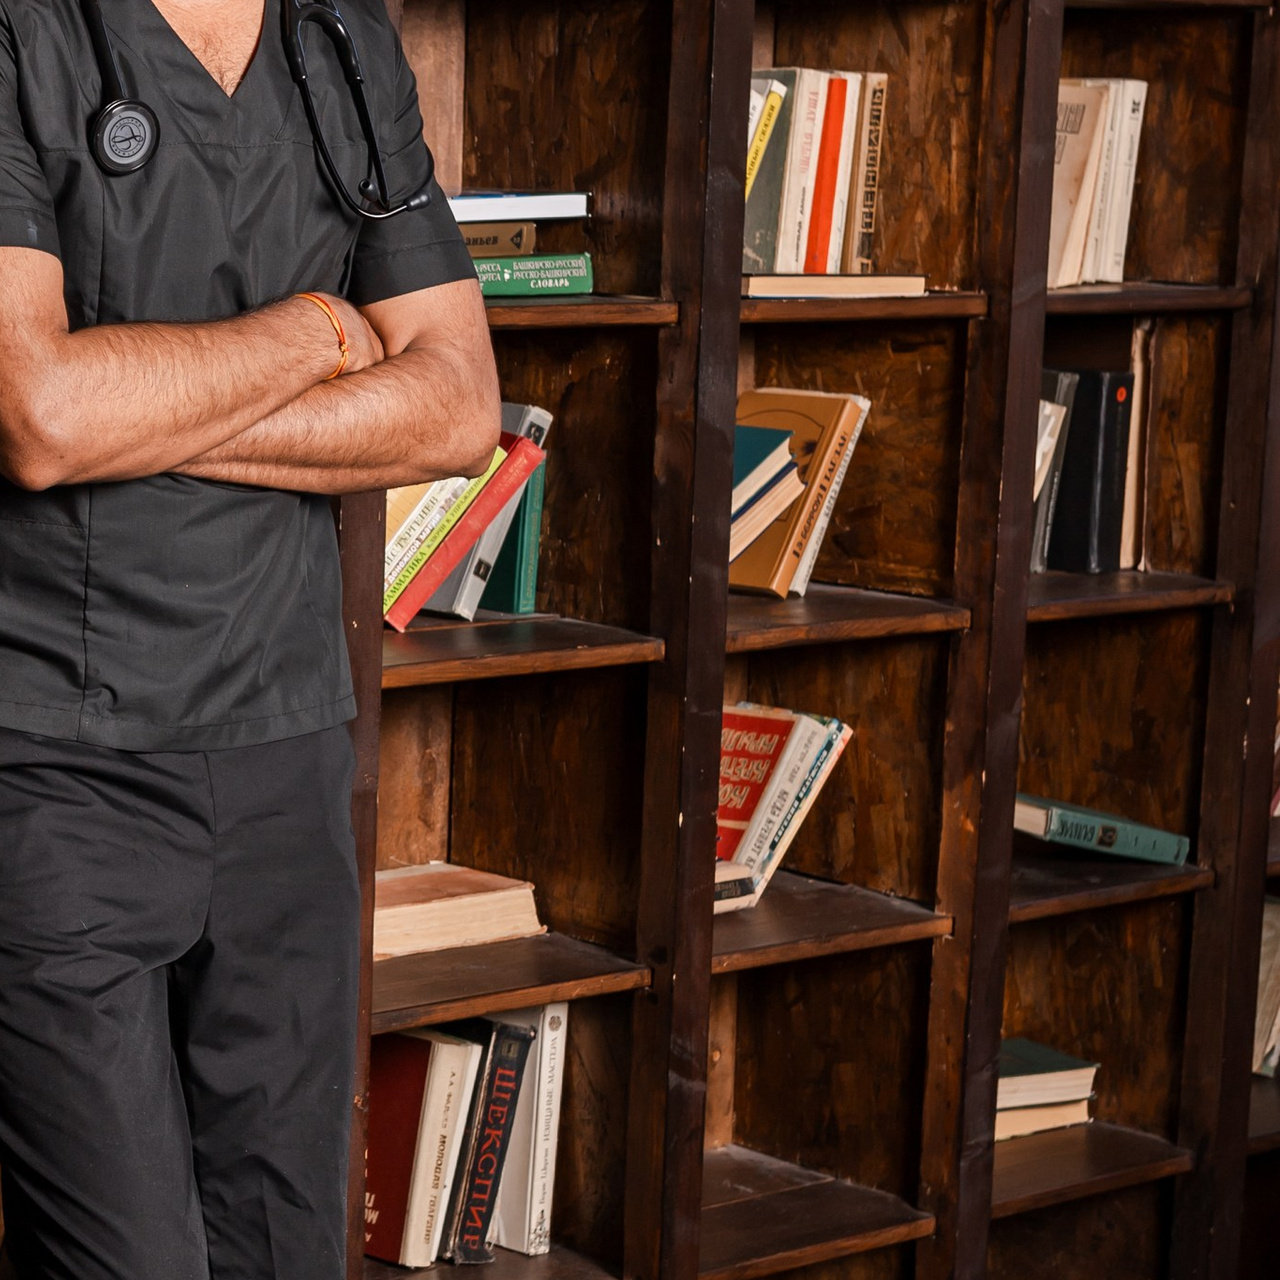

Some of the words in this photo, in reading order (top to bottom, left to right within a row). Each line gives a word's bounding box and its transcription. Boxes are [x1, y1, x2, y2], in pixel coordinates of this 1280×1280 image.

[513, 257, 586, 270] БАШКИРСКО-РУССКИЙ
[513, 267, 587, 281] РУССКО-БАШКИРСКИЙ
[530, 278, 570, 289] СЛОВАРЬ
[390, 494, 443, 551] ТУРГЕНЕВ
[416, 511, 443, 541] магии
[424, 522, 449, 551] КЛЮЧИ
[772, 797, 800, 843] ЕВГЕНИЙ
[545, 1035, 559, 1085] МАСТЕРА
[428, 1132, 448, 1190] МОЛОДАЯ
[458, 1065, 519, 1251] ШЕКСПИР
